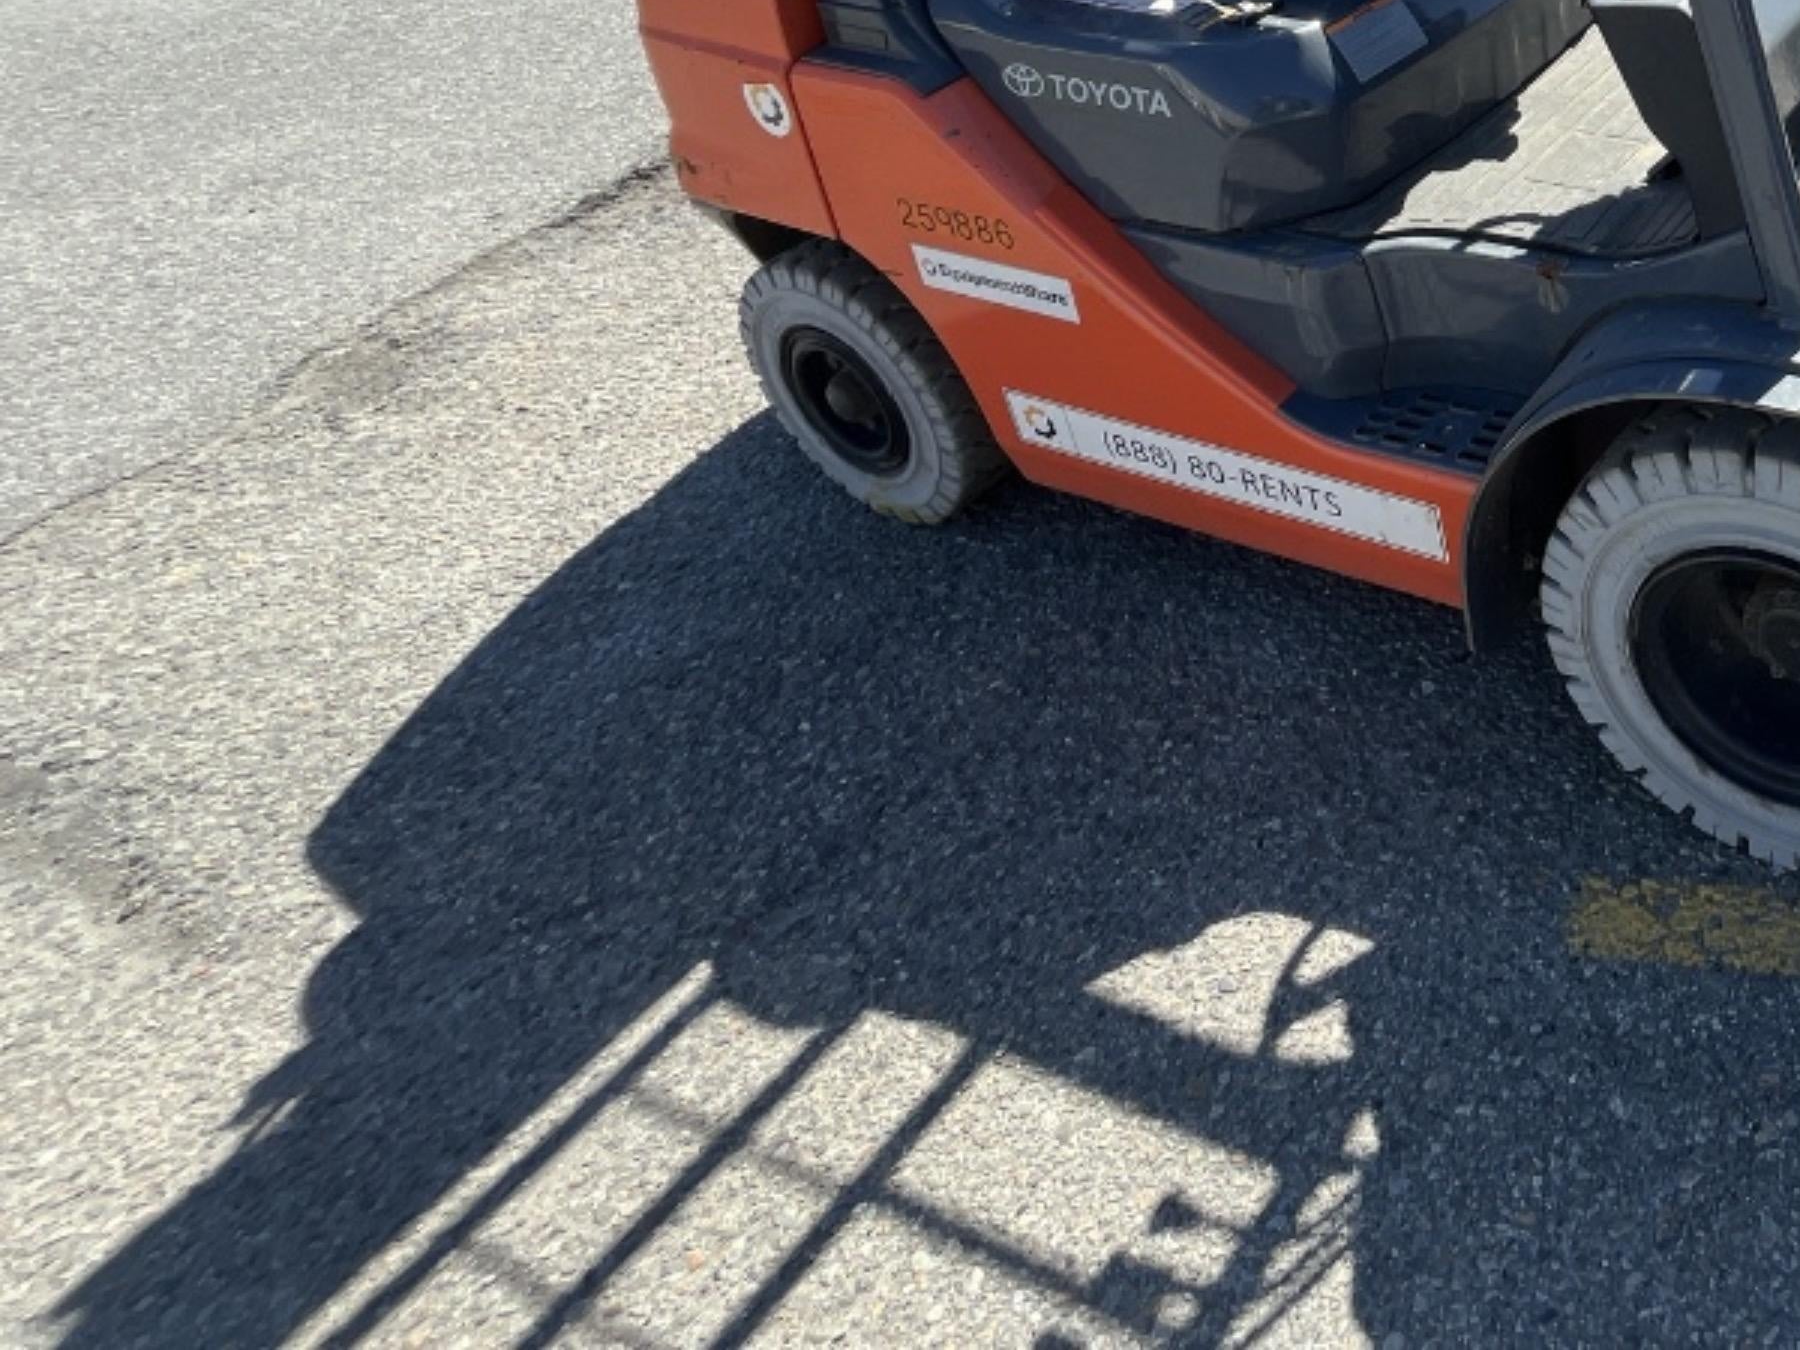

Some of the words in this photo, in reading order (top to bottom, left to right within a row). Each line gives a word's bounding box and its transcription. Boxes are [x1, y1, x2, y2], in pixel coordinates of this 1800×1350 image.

[1048, 73, 1173, 119] TOYOTA
[1102, 430, 1179, 475] (888)
[1187, 453, 1343, 518] 80-RENTS
